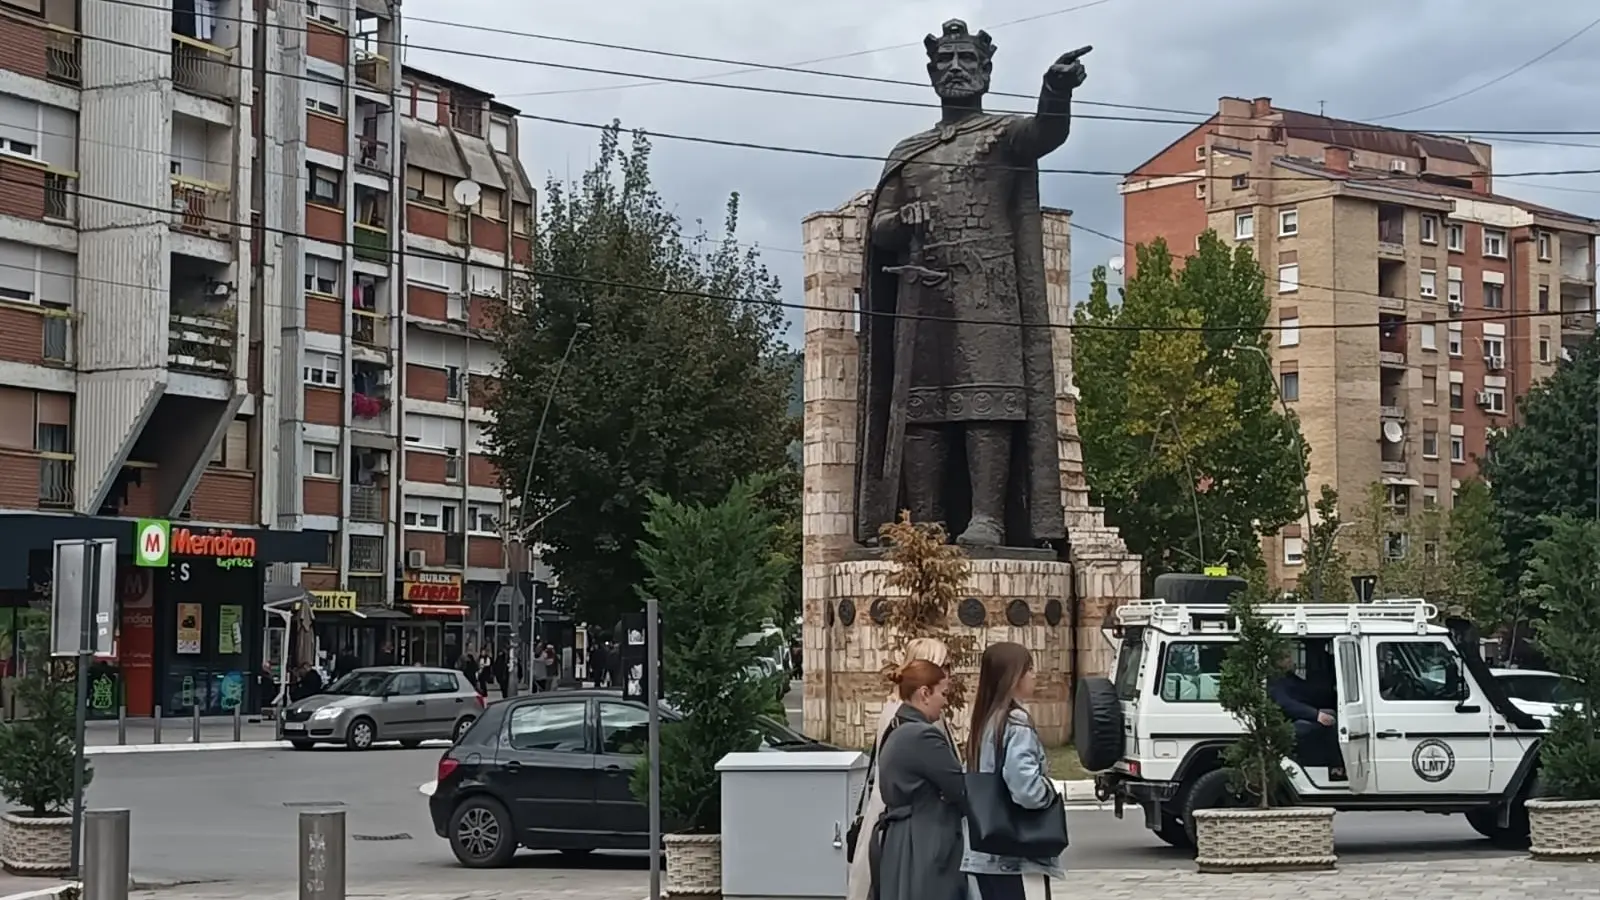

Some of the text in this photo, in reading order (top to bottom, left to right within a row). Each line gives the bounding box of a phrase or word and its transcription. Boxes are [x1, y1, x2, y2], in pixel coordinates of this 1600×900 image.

[145, 533, 160, 552] M
[171, 527, 256, 557] Meridian
[125, 573, 143, 594] M
[420, 573, 450, 584] BUREK
[1422, 760, 1446, 772] LMT
